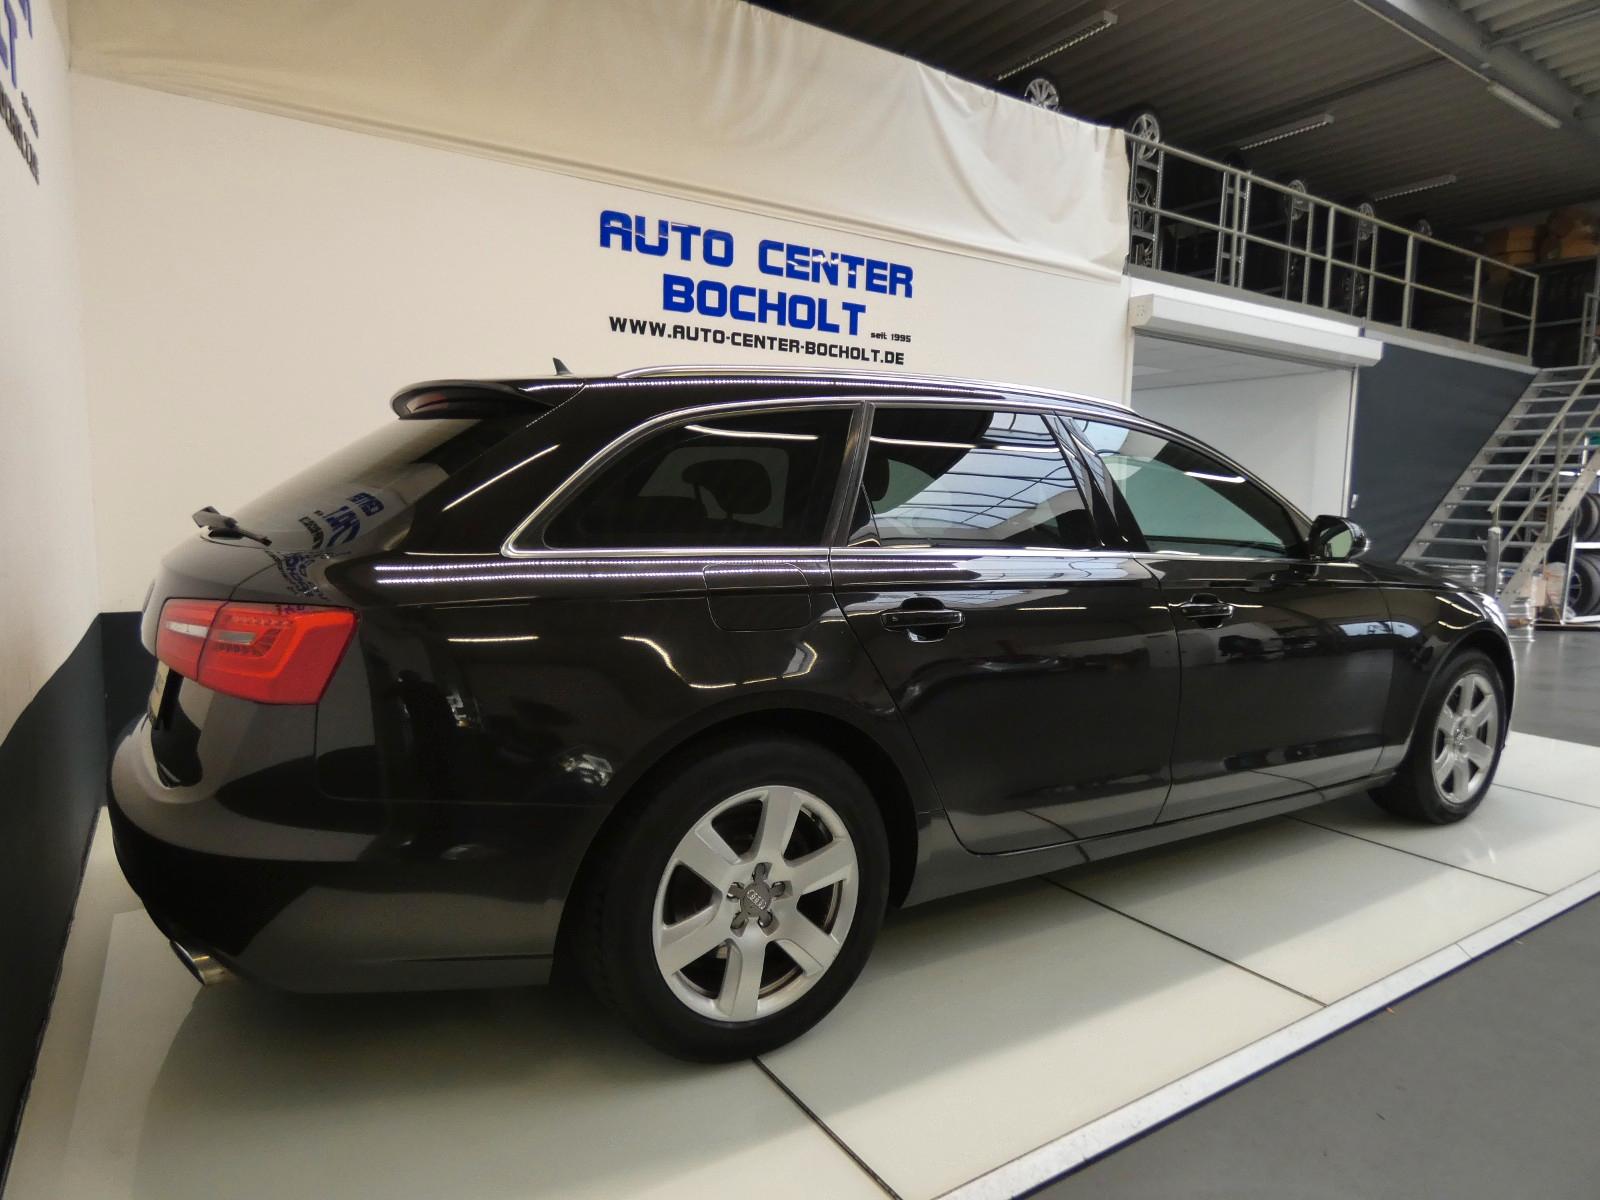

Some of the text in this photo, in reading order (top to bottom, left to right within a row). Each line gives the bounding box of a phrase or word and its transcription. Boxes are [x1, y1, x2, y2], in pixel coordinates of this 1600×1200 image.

[599, 209, 914, 298] AUTO CENTER
[662, 273, 866, 336] BOCHOLT
[870, 331, 912, 343] seit 1995
